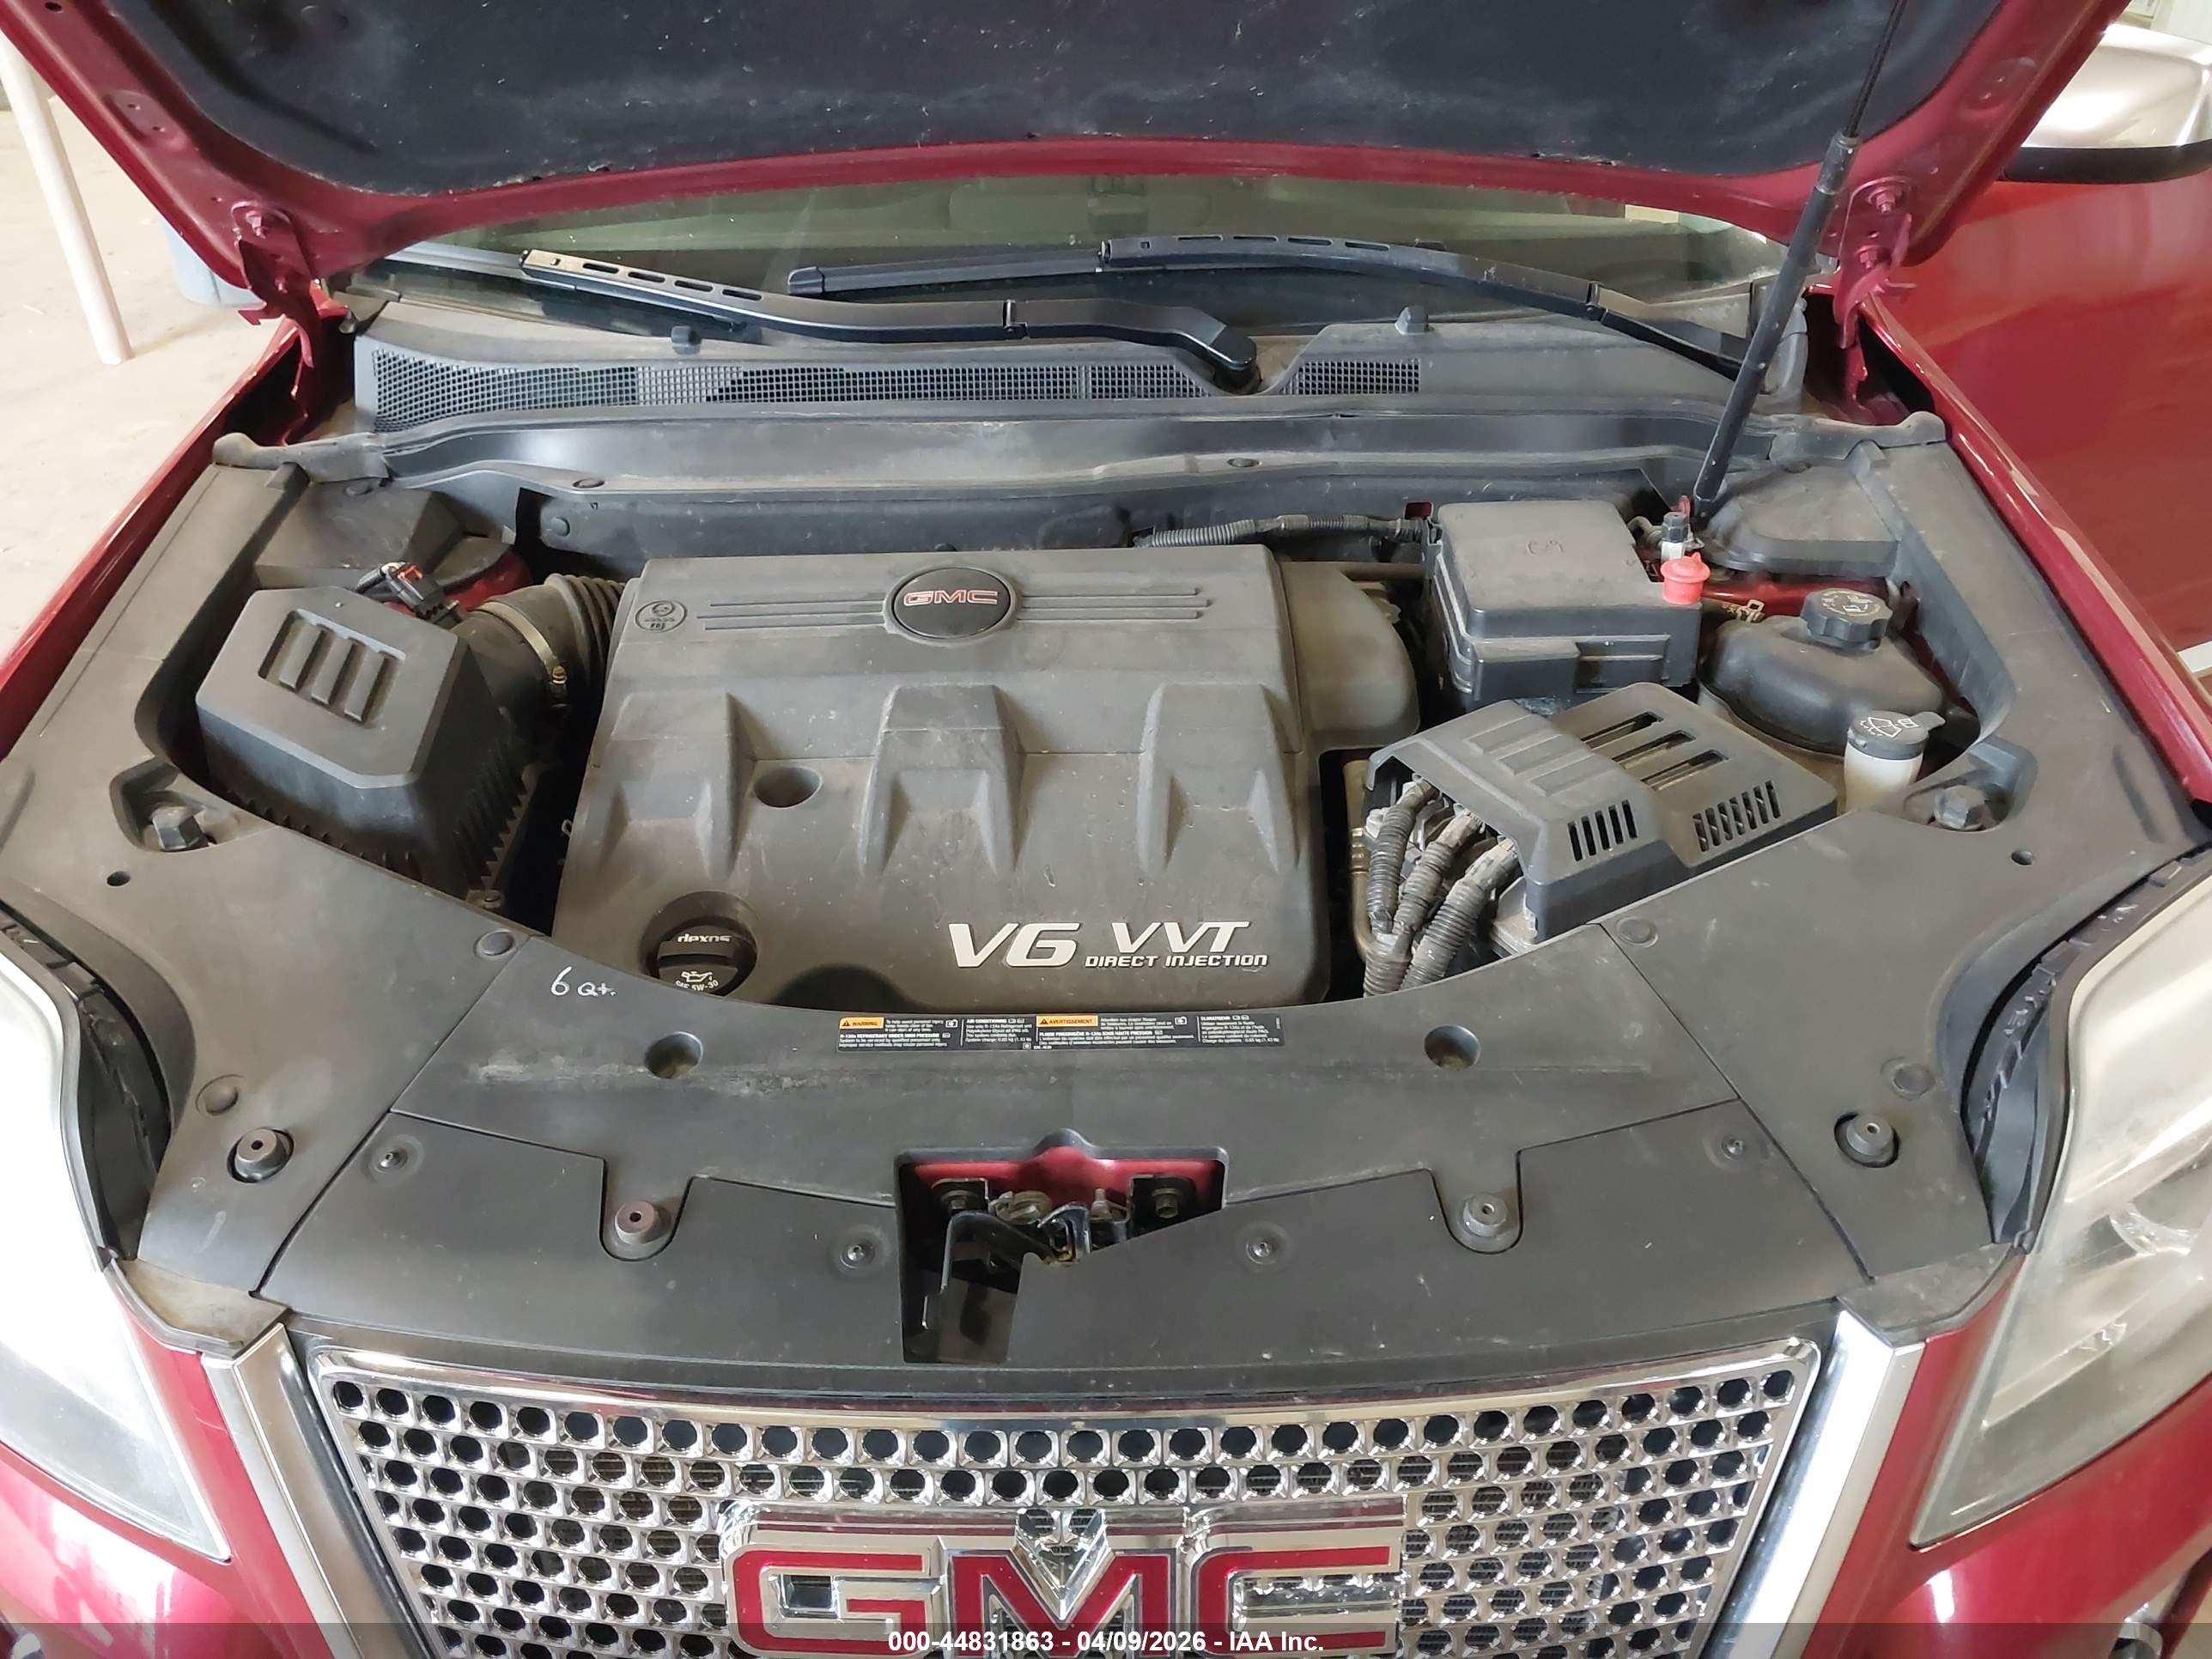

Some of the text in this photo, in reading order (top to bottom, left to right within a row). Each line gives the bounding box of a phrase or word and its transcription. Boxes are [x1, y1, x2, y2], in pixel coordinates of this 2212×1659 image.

[904, 590, 998, 606] GMC
[948, 921, 1250, 968] V6 VVT
[1085, 954, 1268, 968] DIRECT INJECTION
[550, 966, 573, 995] 6
[723, 1543, 1403, 1658] GMC
